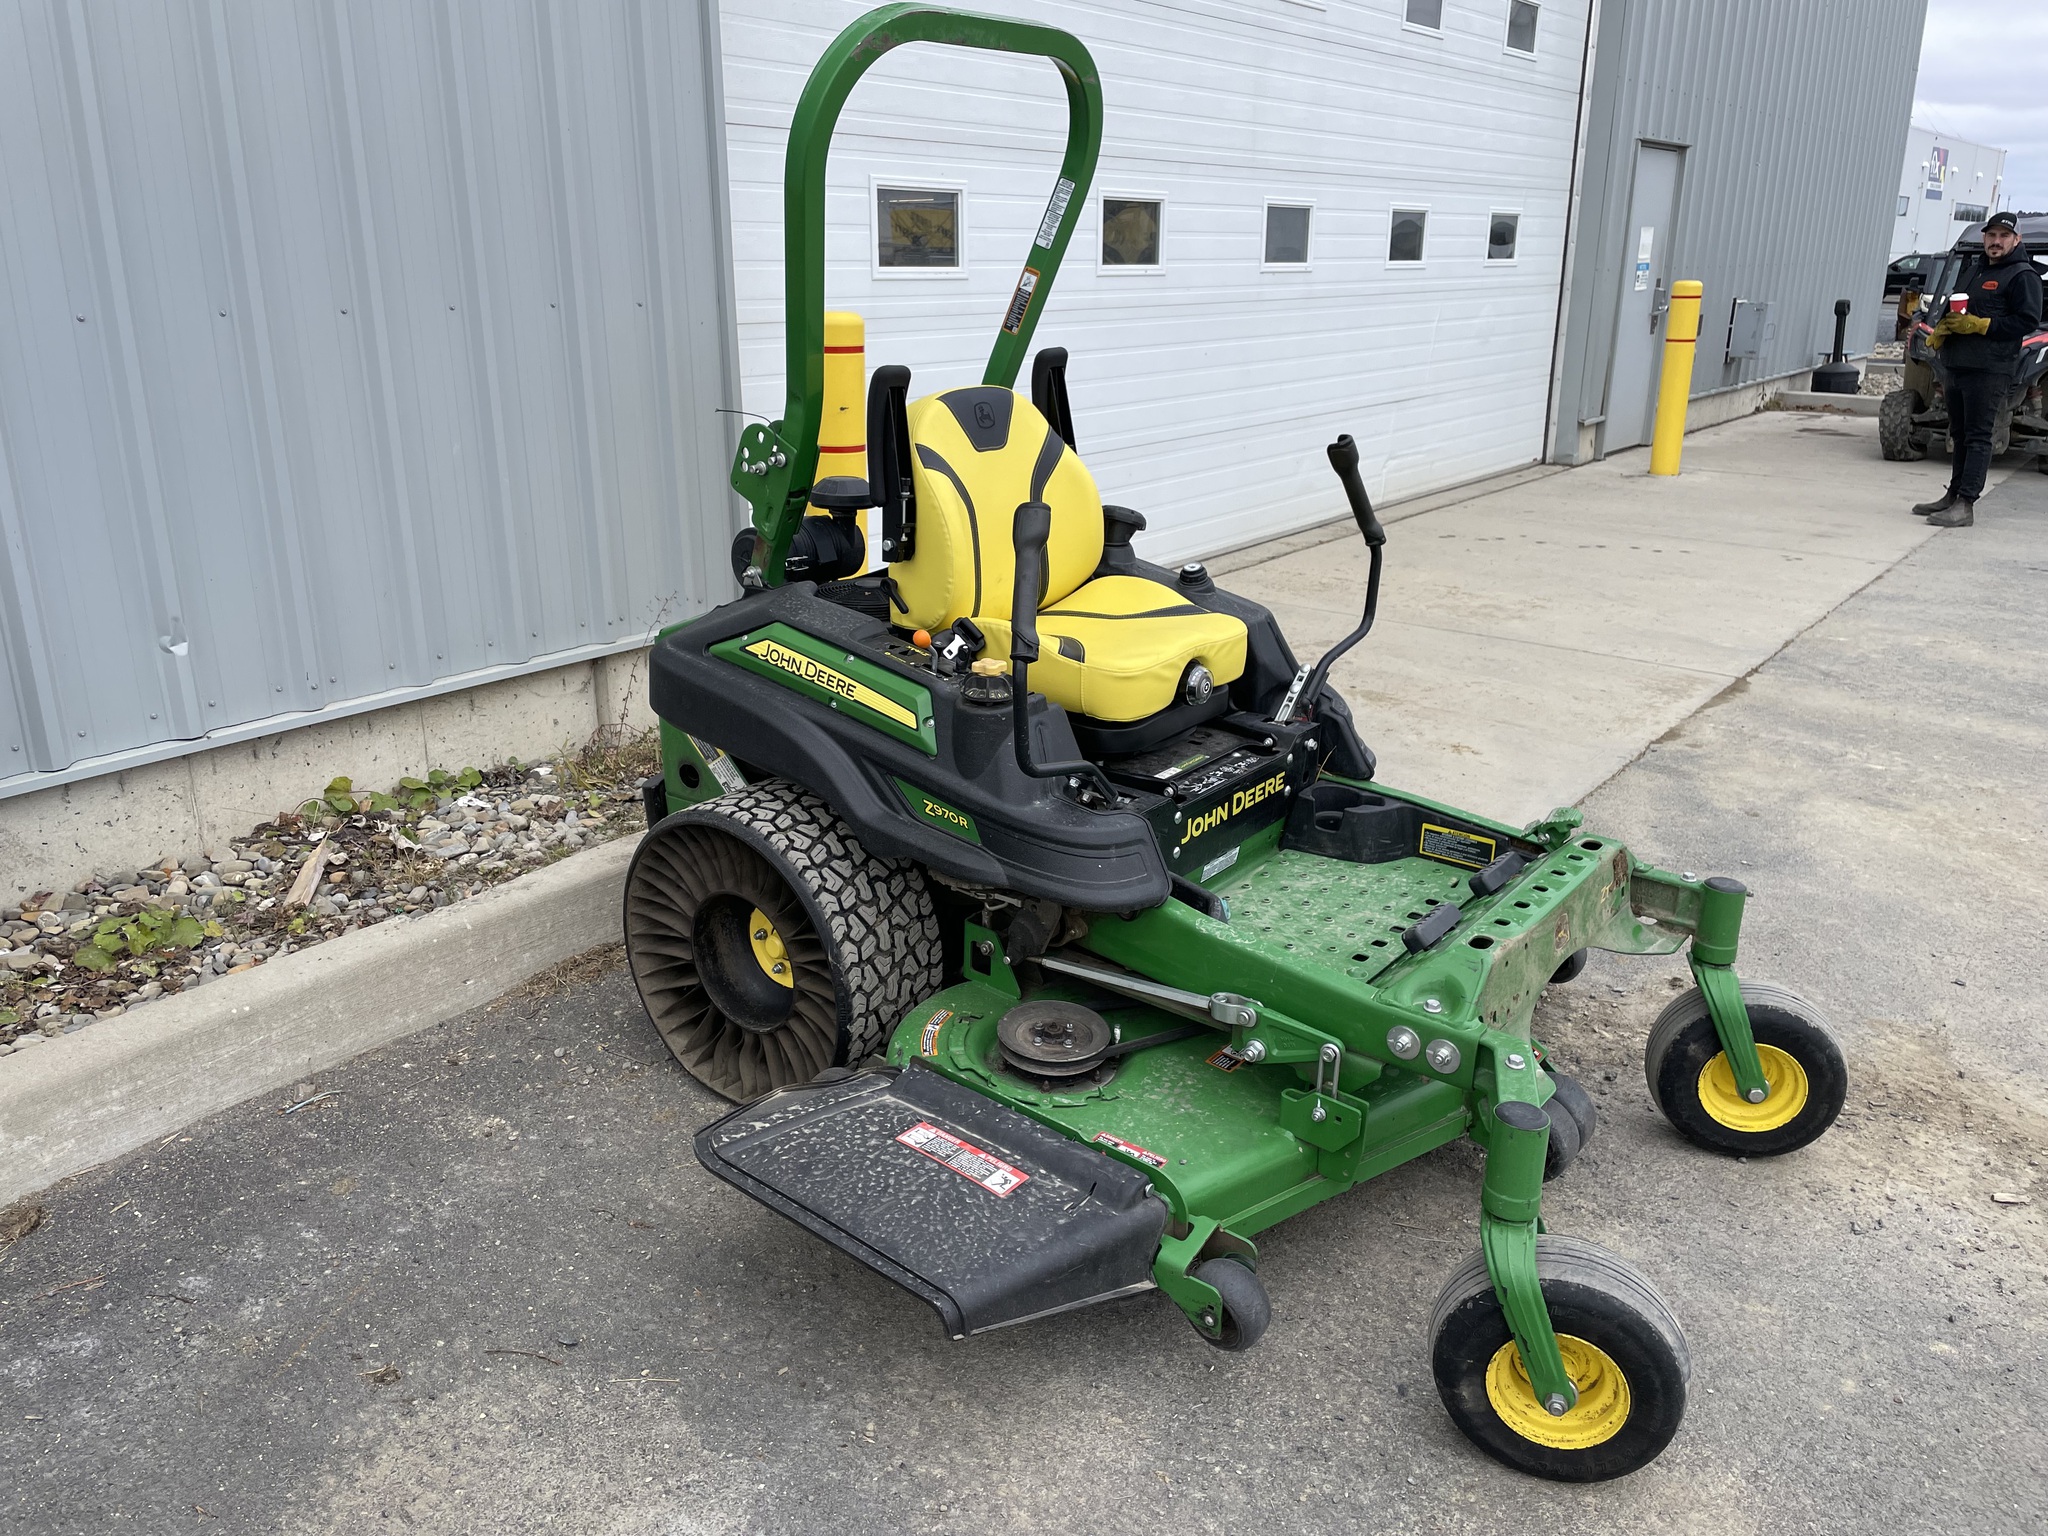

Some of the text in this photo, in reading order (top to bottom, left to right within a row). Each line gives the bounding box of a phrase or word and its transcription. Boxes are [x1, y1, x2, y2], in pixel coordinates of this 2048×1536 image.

[760, 643, 857, 699] JOHN DEERE
[922, 798, 969, 830] Z970R
[1181, 771, 1286, 845] JOHN DEERE
[936, 1130, 961, 1145] DANGER
[986, 1153, 1013, 1172] PELIGRO
